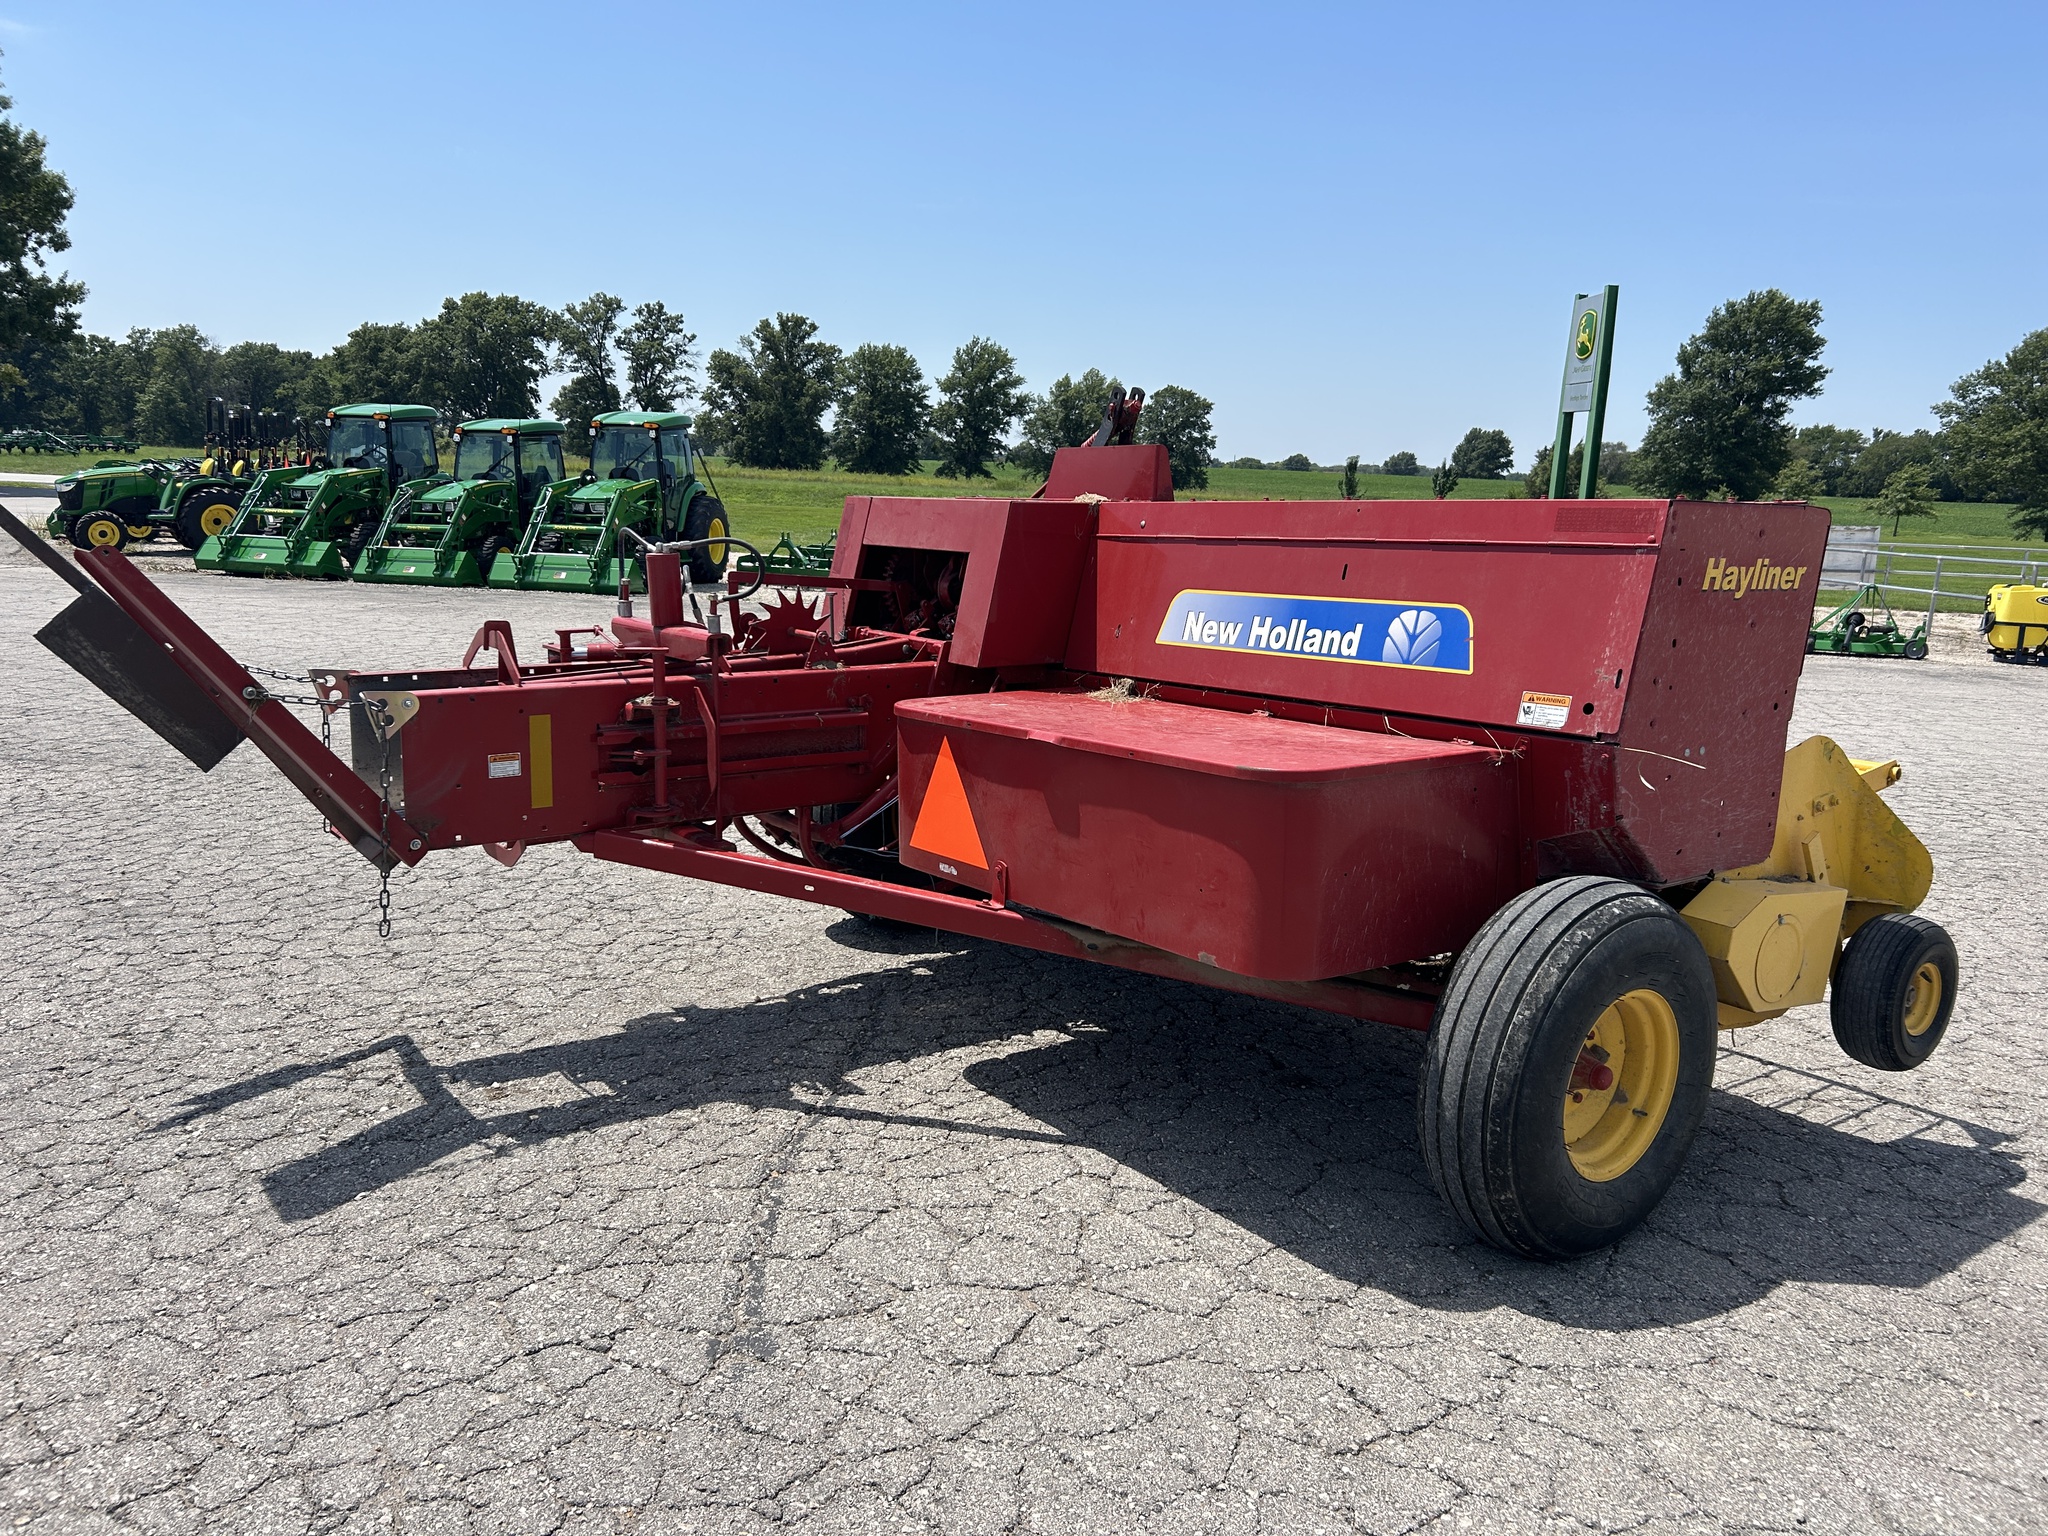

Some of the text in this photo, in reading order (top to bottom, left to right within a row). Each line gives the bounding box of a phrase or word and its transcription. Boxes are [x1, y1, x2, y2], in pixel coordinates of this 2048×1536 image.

[1701, 557, 1808, 600] Hayliner
[1182, 611, 1364, 657] New Holland
[1535, 695, 1567, 705] WARNING
